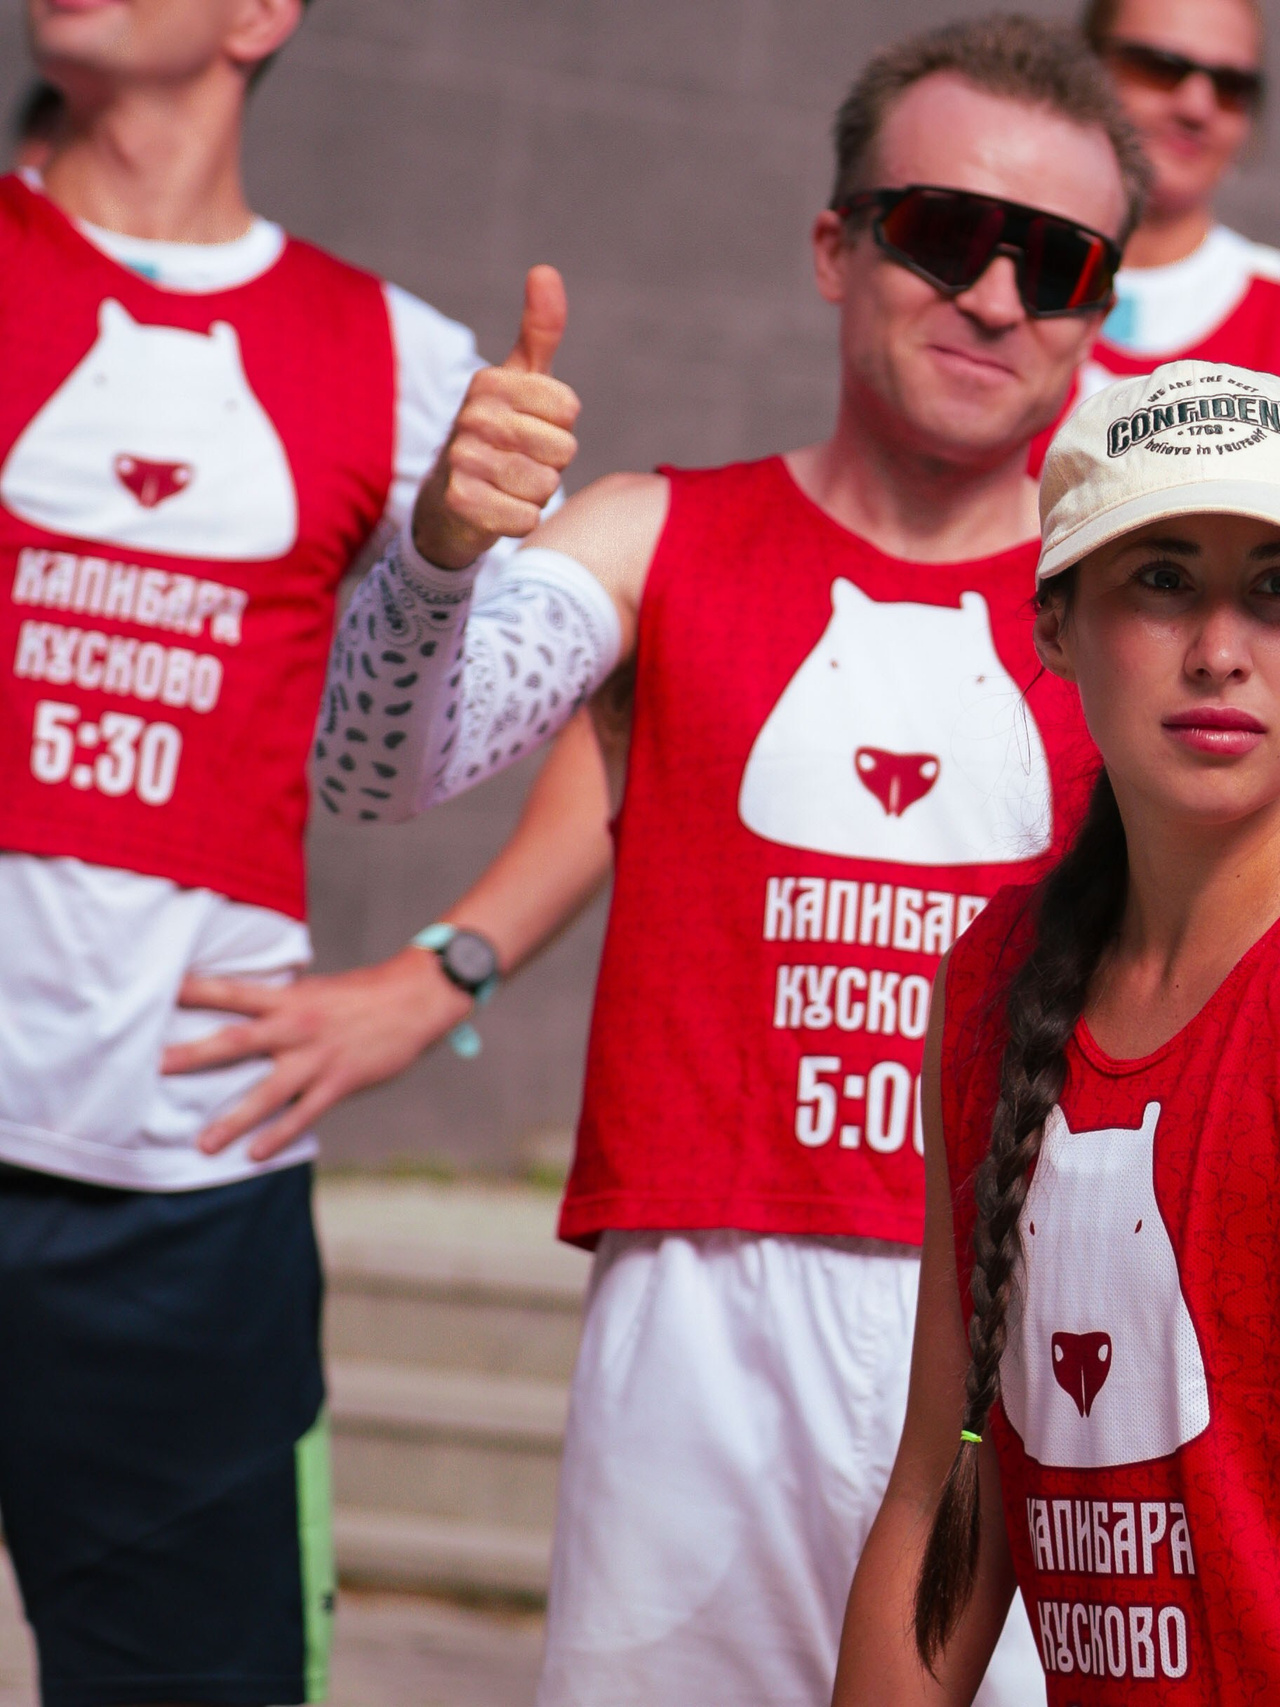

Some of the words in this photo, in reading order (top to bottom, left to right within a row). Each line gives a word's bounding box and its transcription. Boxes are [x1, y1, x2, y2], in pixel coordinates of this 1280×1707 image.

[1147, 387, 1166, 403] WE
[1168, 379, 1193, 391] ARE
[1199, 374, 1223, 384] THE
[1227, 378, 1260, 394] BEST
[1143, 437, 1192, 456] believe
[1196, 444, 1212, 455] in
[1215, 427, 1268, 456] yourself
[11, 547, 248, 646] КАПИБАРА
[13, 619, 223, 714] КУСКОВО
[30, 699, 183, 806] 5:30
[763, 876, 989, 955] КАПИБАР
[773, 964, 932, 1040] КУСКО
[794, 1055, 925, 1158] 5:0
[1037, 1600, 1188, 1679] КУСКОВО
